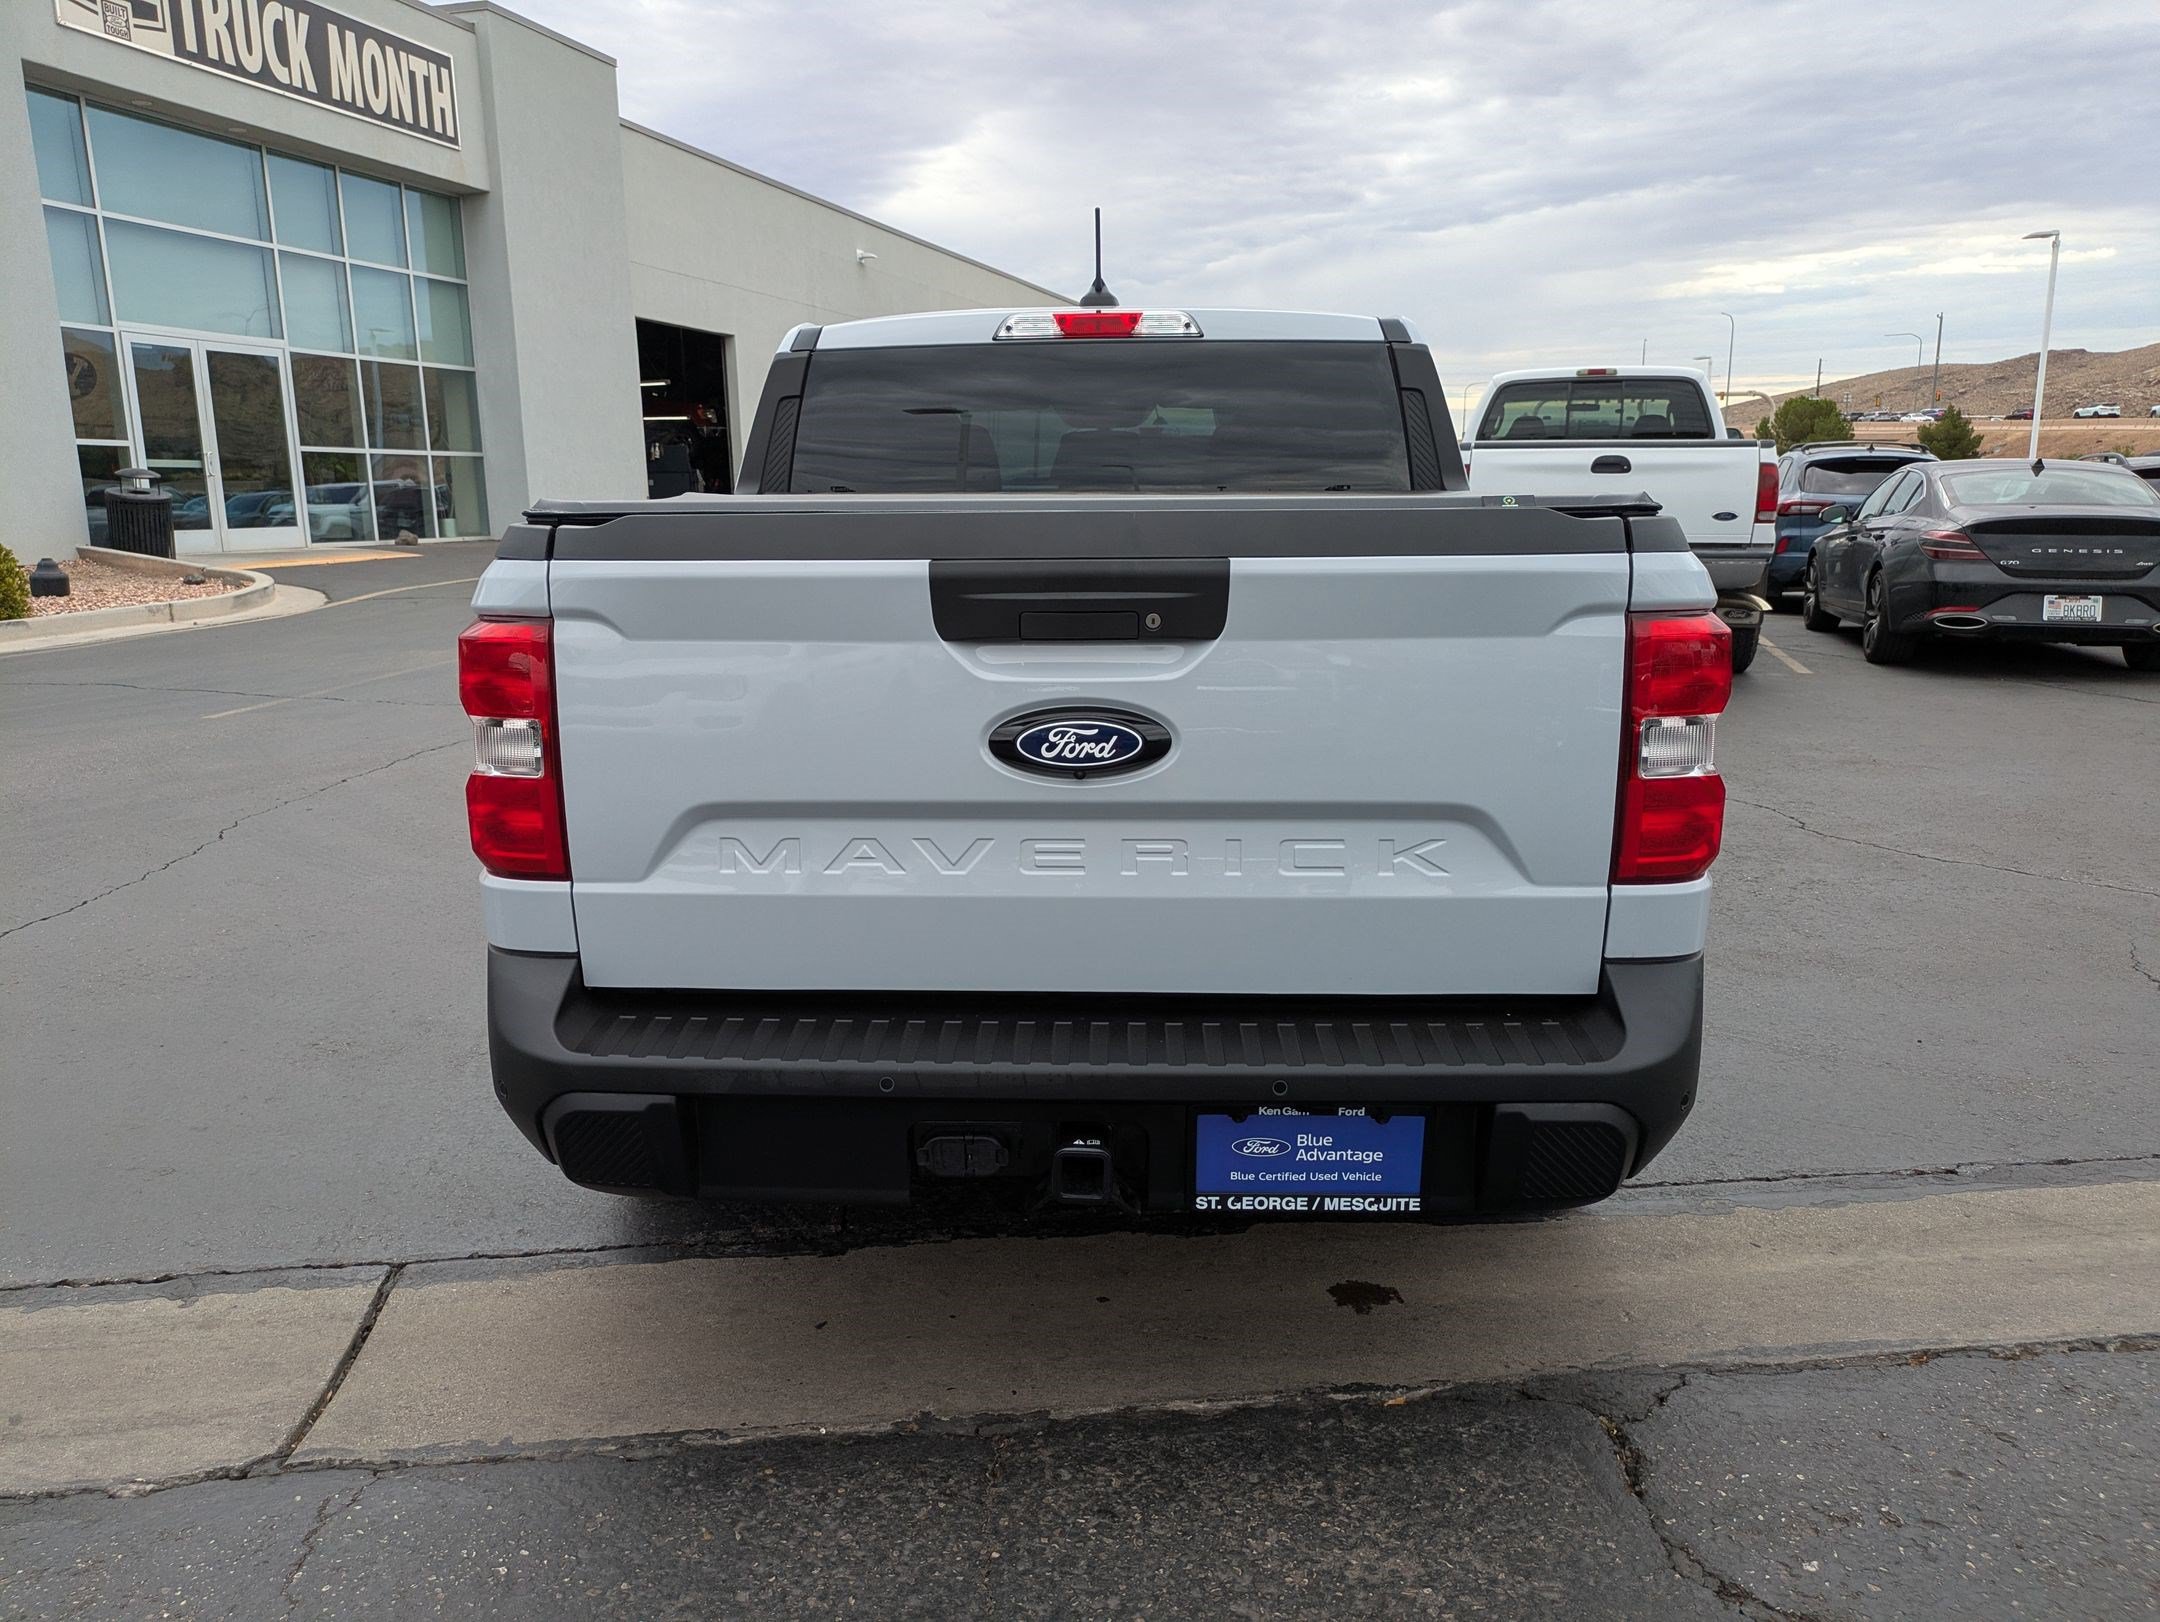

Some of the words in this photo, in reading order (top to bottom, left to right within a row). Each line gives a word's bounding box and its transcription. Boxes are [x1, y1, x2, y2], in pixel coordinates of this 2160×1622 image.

[103, 3, 126, 18] BUILT
[106, 24, 129, 39] TOUGH
[180, 0, 319, 94] TRUCK
[327, 22, 456, 138] MONTH
[1041, 727, 1119, 758] Ford
[718, 836, 1452, 878] MAVERICK
[1258, 1106, 1281, 1116] Ken
[1338, 1107, 1366, 1117] Ford
[1243, 1140, 1281, 1155] Ford
[1297, 1134, 1333, 1147] Blue
[1296, 1148, 1384, 1164] Advantage
[1230, 1171, 1256, 1181] Blue
[1258, 1171, 1307, 1182] Certified
[1310, 1172, 1338, 1182] Used
[1342, 1172, 1383, 1182] Vehicle
[1195, 1196, 1223, 1210] ST.
[1227, 1196, 1309, 1211] GEORGE
[1324, 1197, 1421, 1212] MESQUITE
